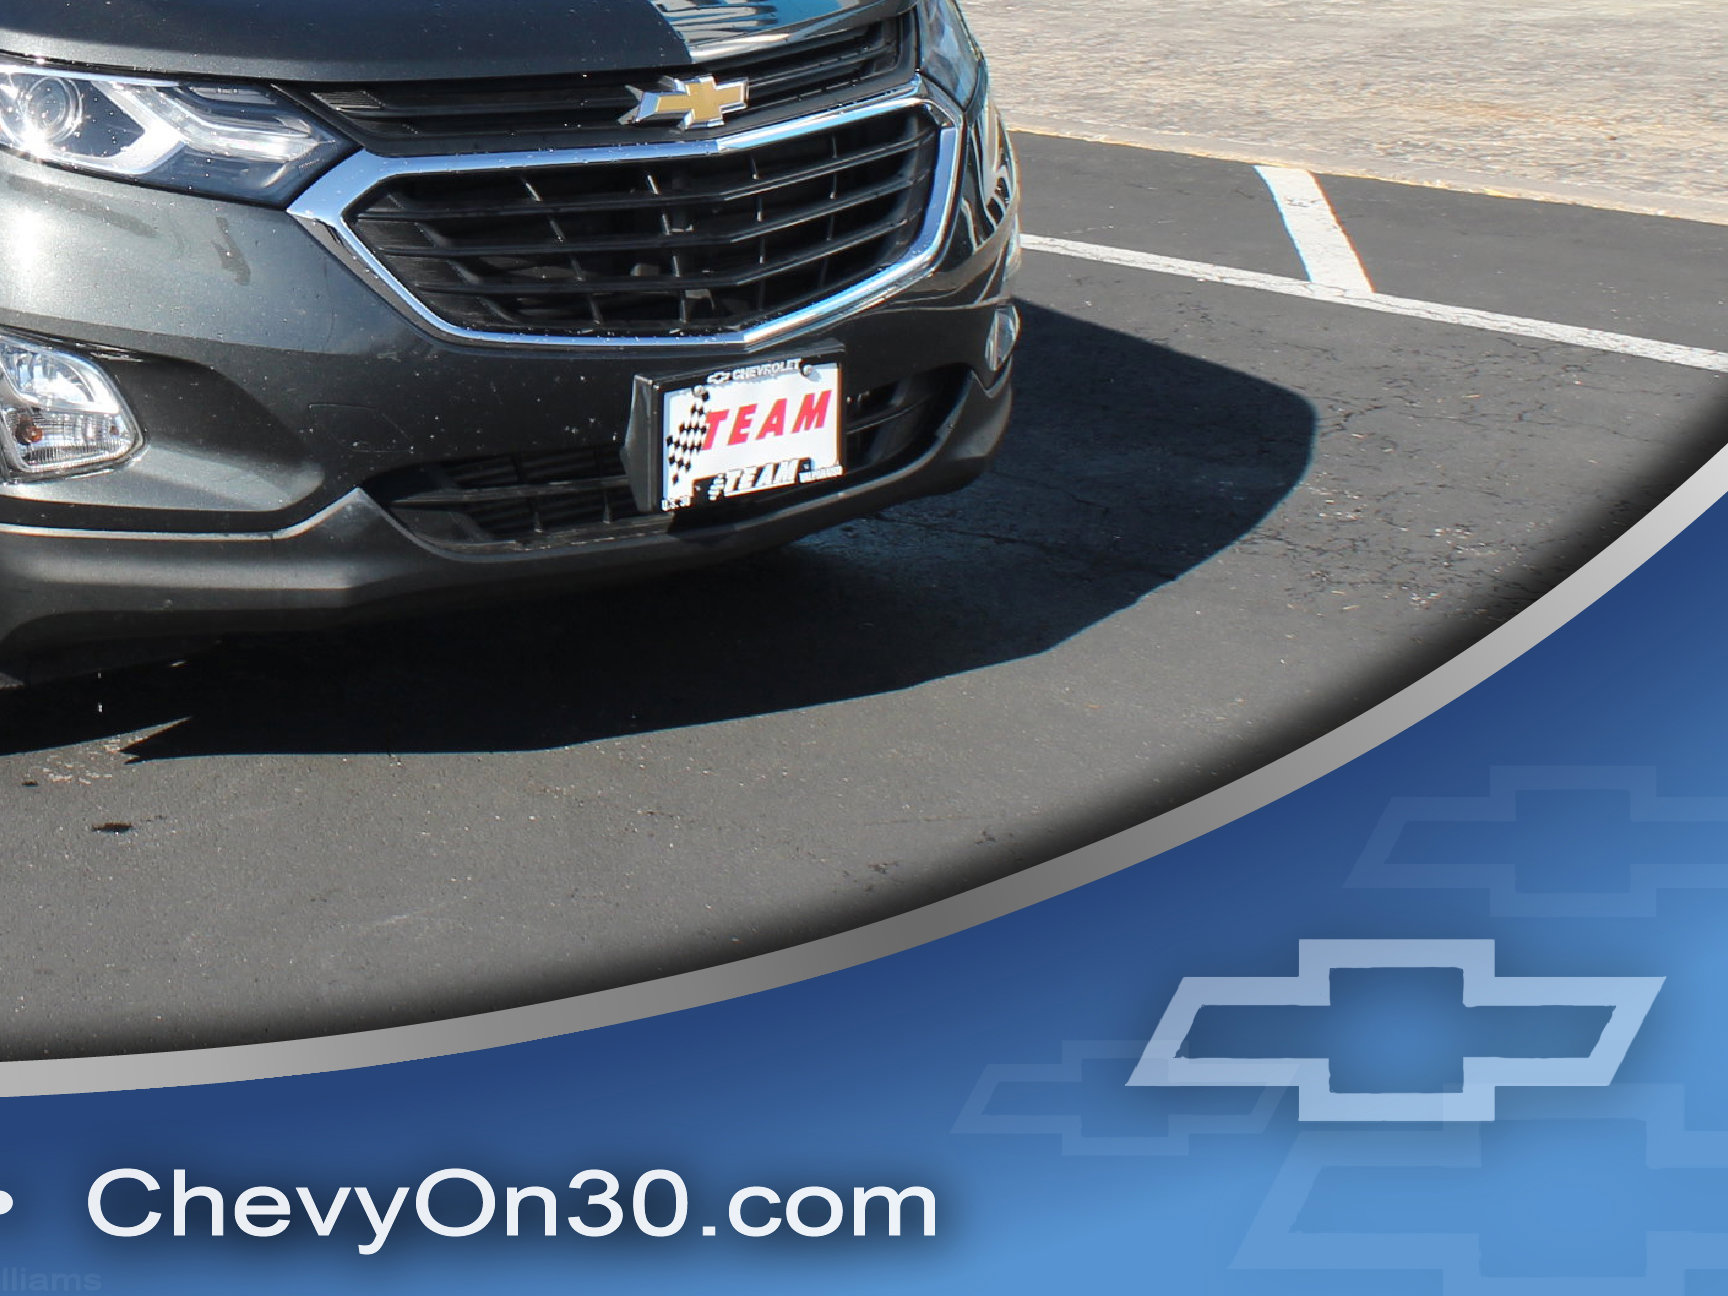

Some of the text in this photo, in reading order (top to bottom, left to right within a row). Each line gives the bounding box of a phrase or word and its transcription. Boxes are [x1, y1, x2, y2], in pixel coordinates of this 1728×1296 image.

[732, 357, 802, 381] CHEVROLET
[702, 390, 832, 451] TEAM
[723, 458, 801, 497] TEAM
